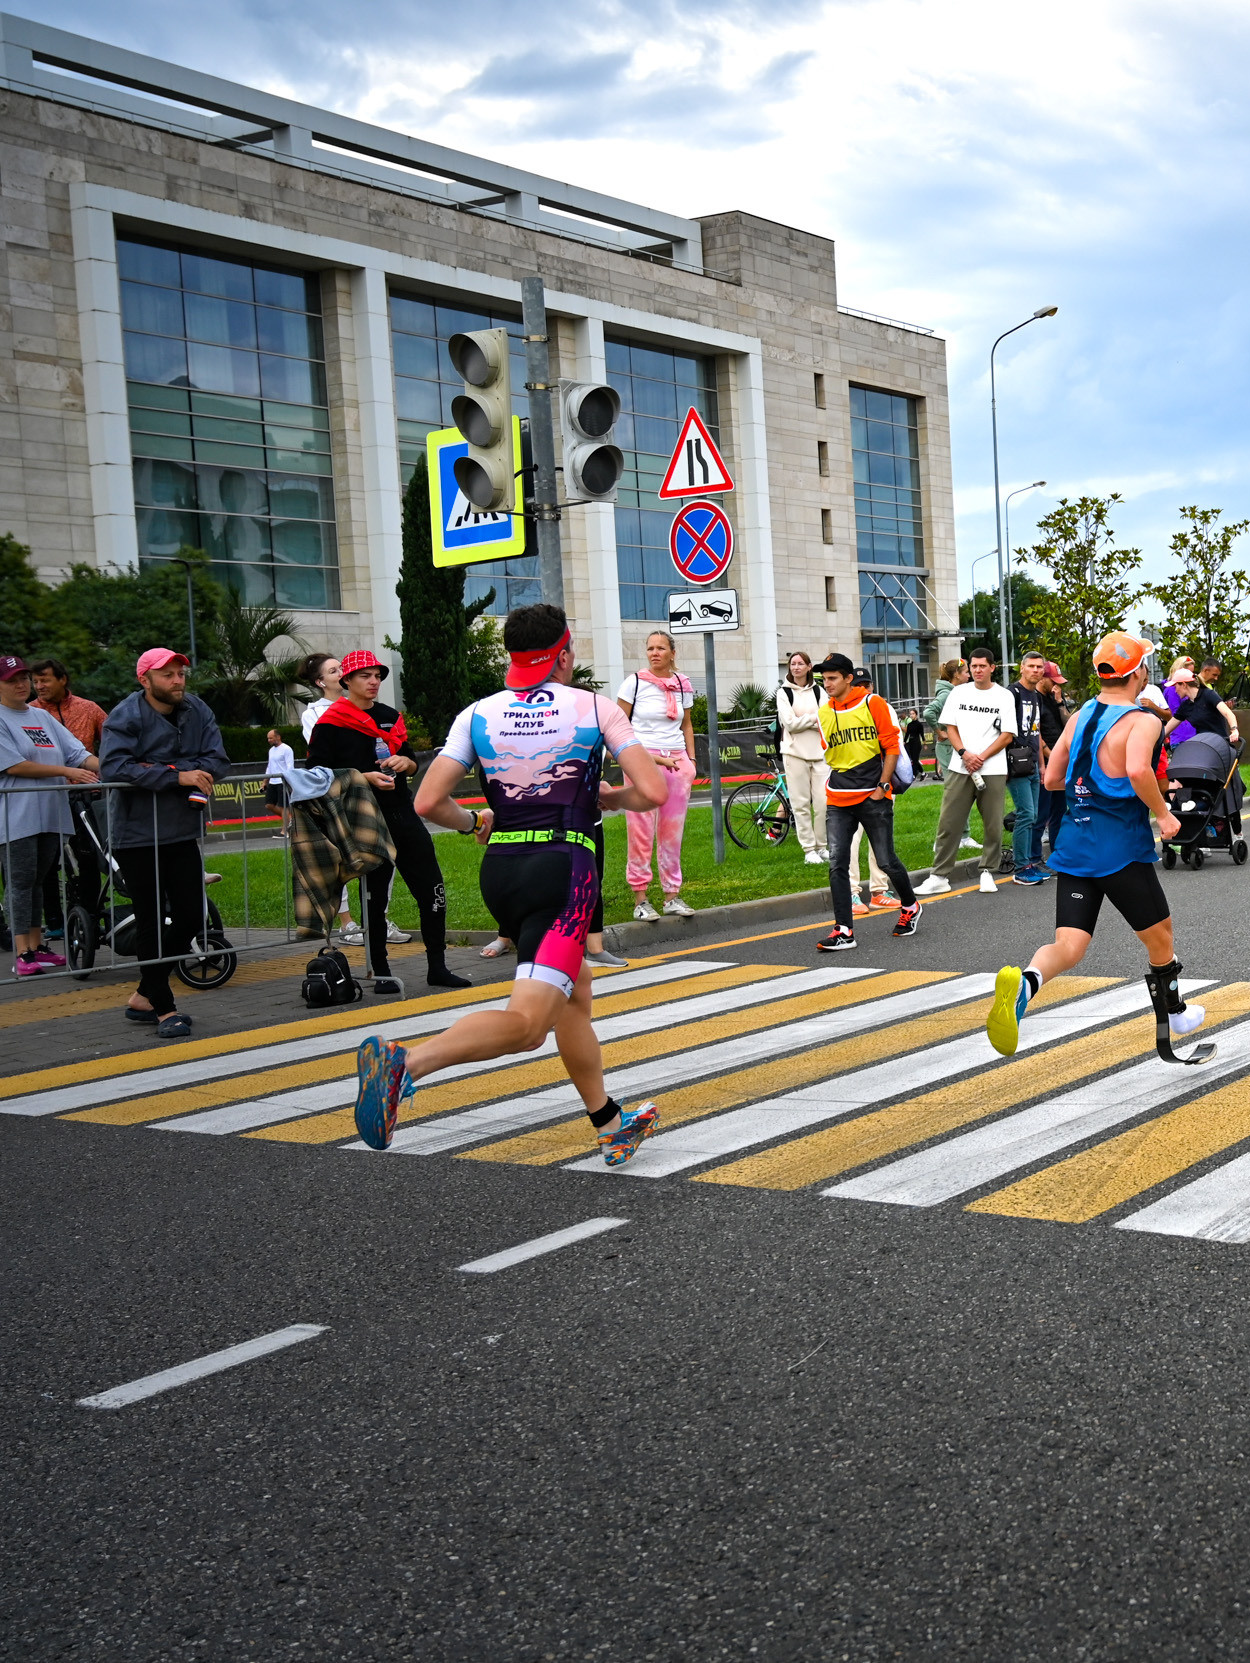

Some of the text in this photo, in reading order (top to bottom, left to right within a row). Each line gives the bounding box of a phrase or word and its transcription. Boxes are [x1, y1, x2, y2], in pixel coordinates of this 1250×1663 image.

[503, 709, 559, 719] ТРИАТЛОН
[969, 705, 1000, 715] SANDER
[514, 721, 545, 729] КЛУБ
[23, 728, 47, 738] MNC
[828, 726, 878, 749] VOLUNTEER
[727, 746, 741, 757] STAR
[213, 783, 235, 797] IRON
